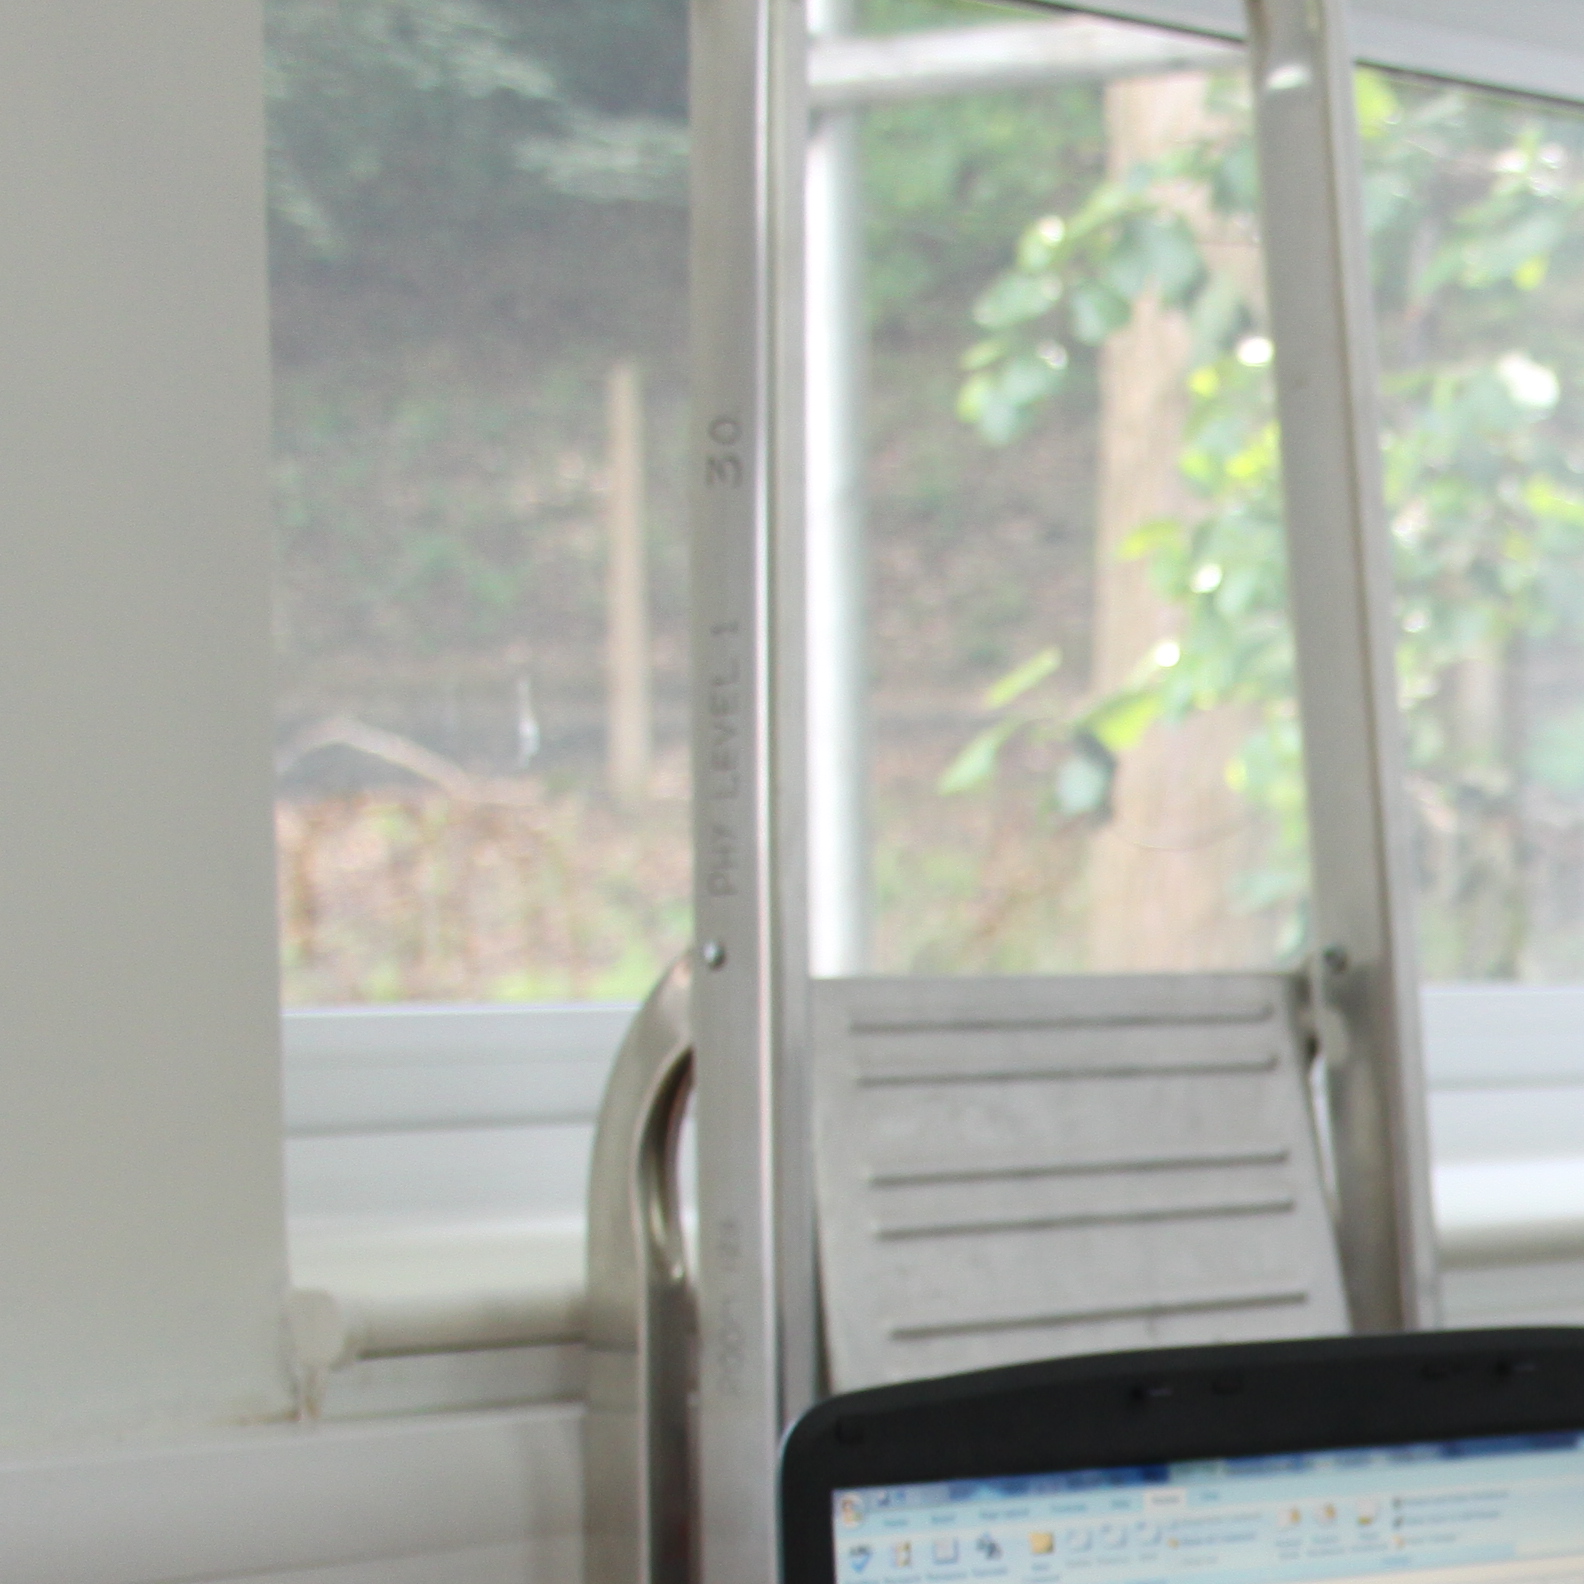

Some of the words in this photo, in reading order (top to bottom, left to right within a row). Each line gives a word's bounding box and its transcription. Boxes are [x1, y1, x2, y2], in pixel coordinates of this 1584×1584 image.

[704, 414, 743, 490] 30
[708, 657, 741, 801] LEVEL
[707, 825, 738, 897] PHY
